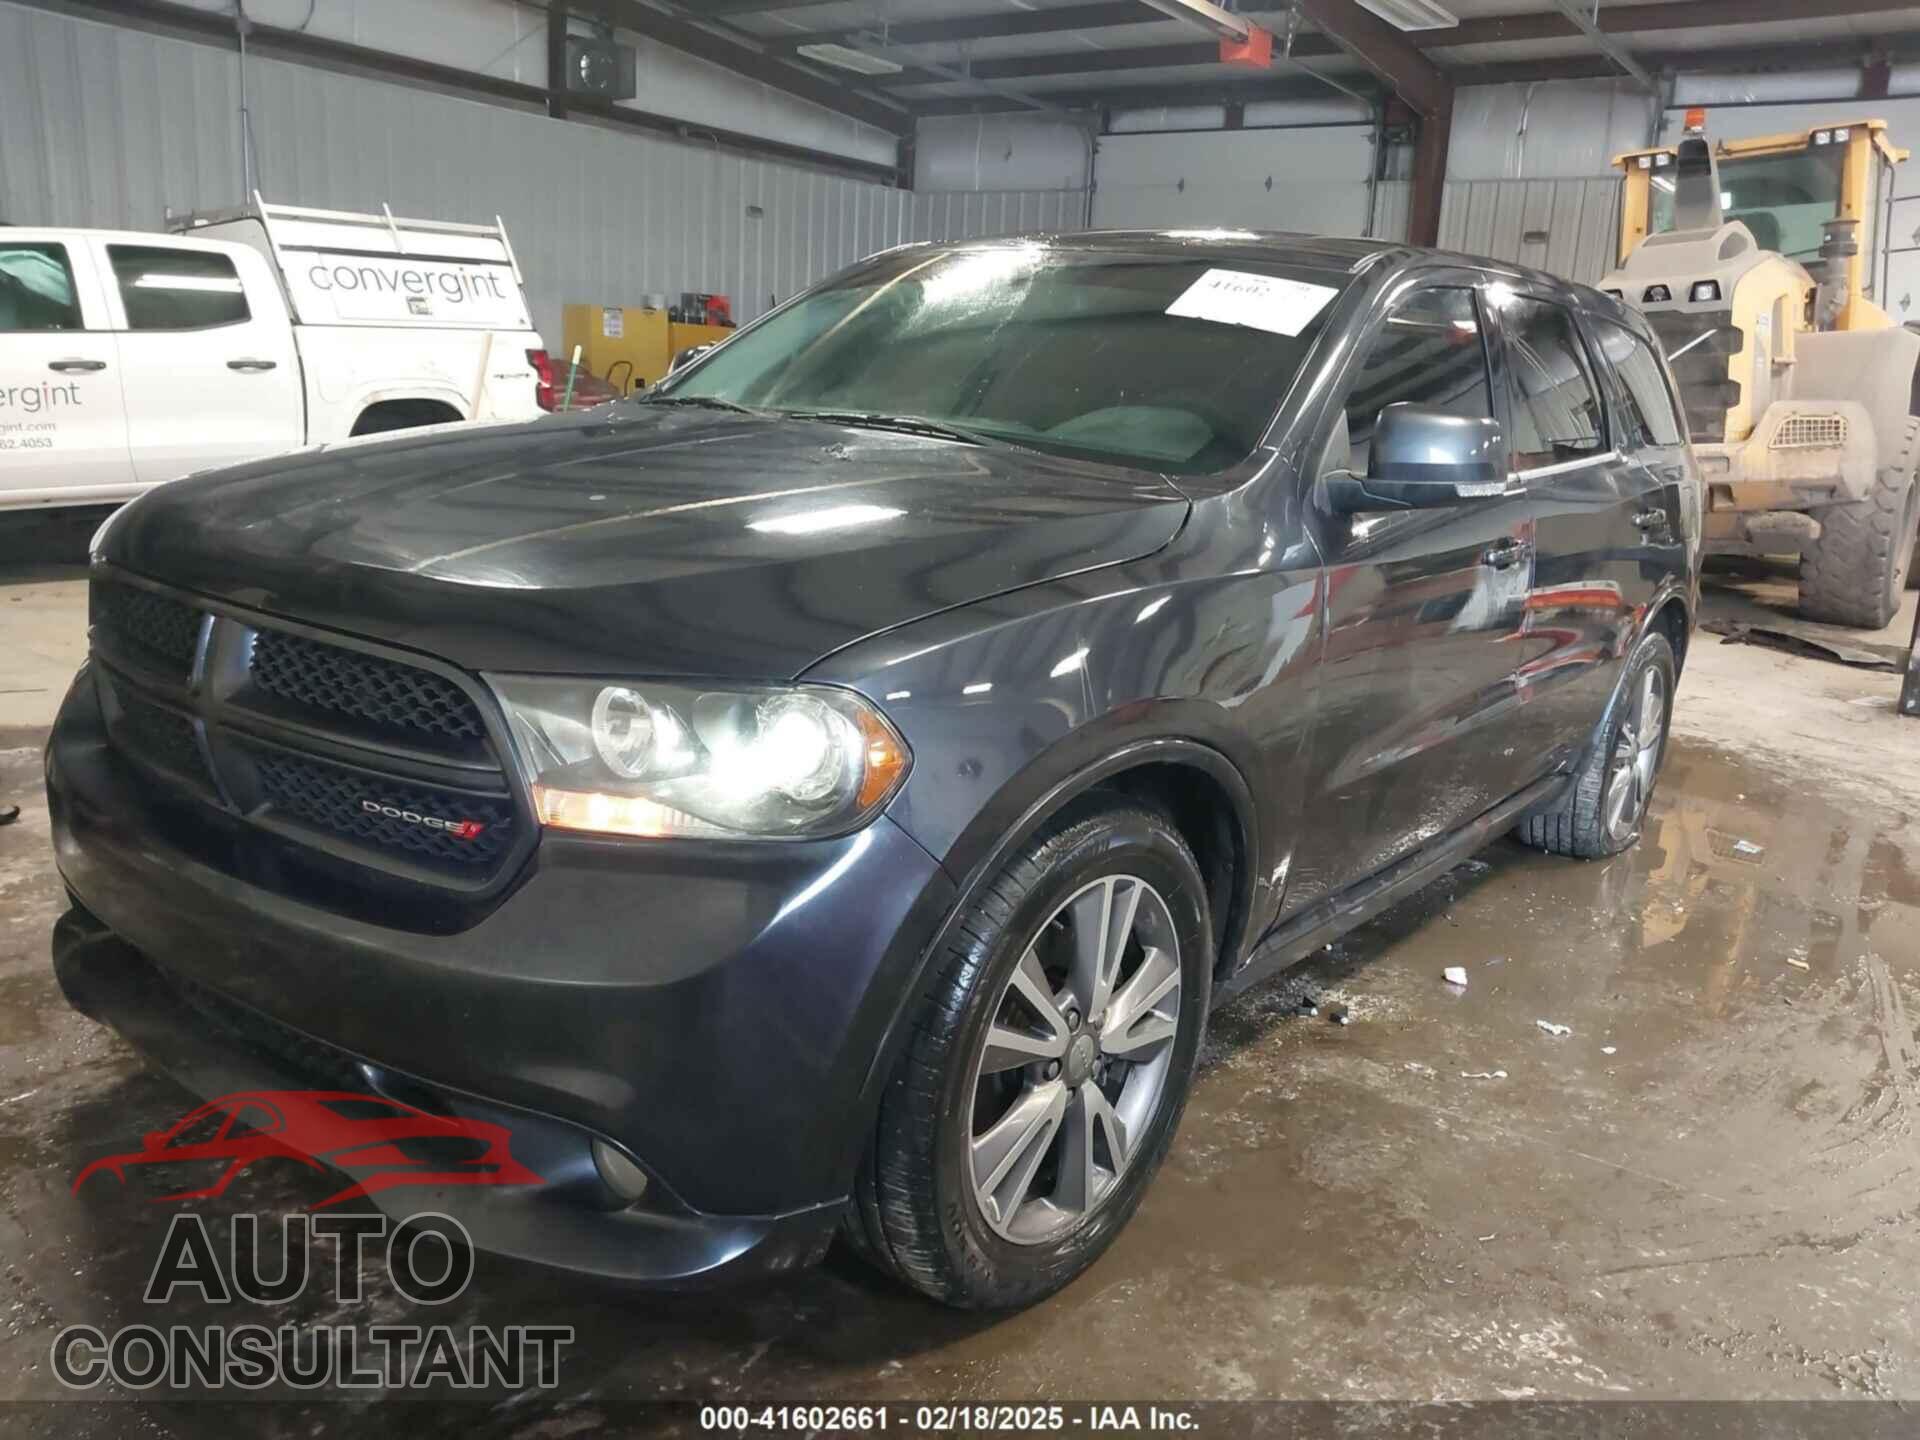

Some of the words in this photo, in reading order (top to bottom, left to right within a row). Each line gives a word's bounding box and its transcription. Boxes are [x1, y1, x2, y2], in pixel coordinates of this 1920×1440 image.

[309, 265, 506, 304] convergint
[0, 381, 82, 413] rgint
[362, 800, 465, 834] DODGE
